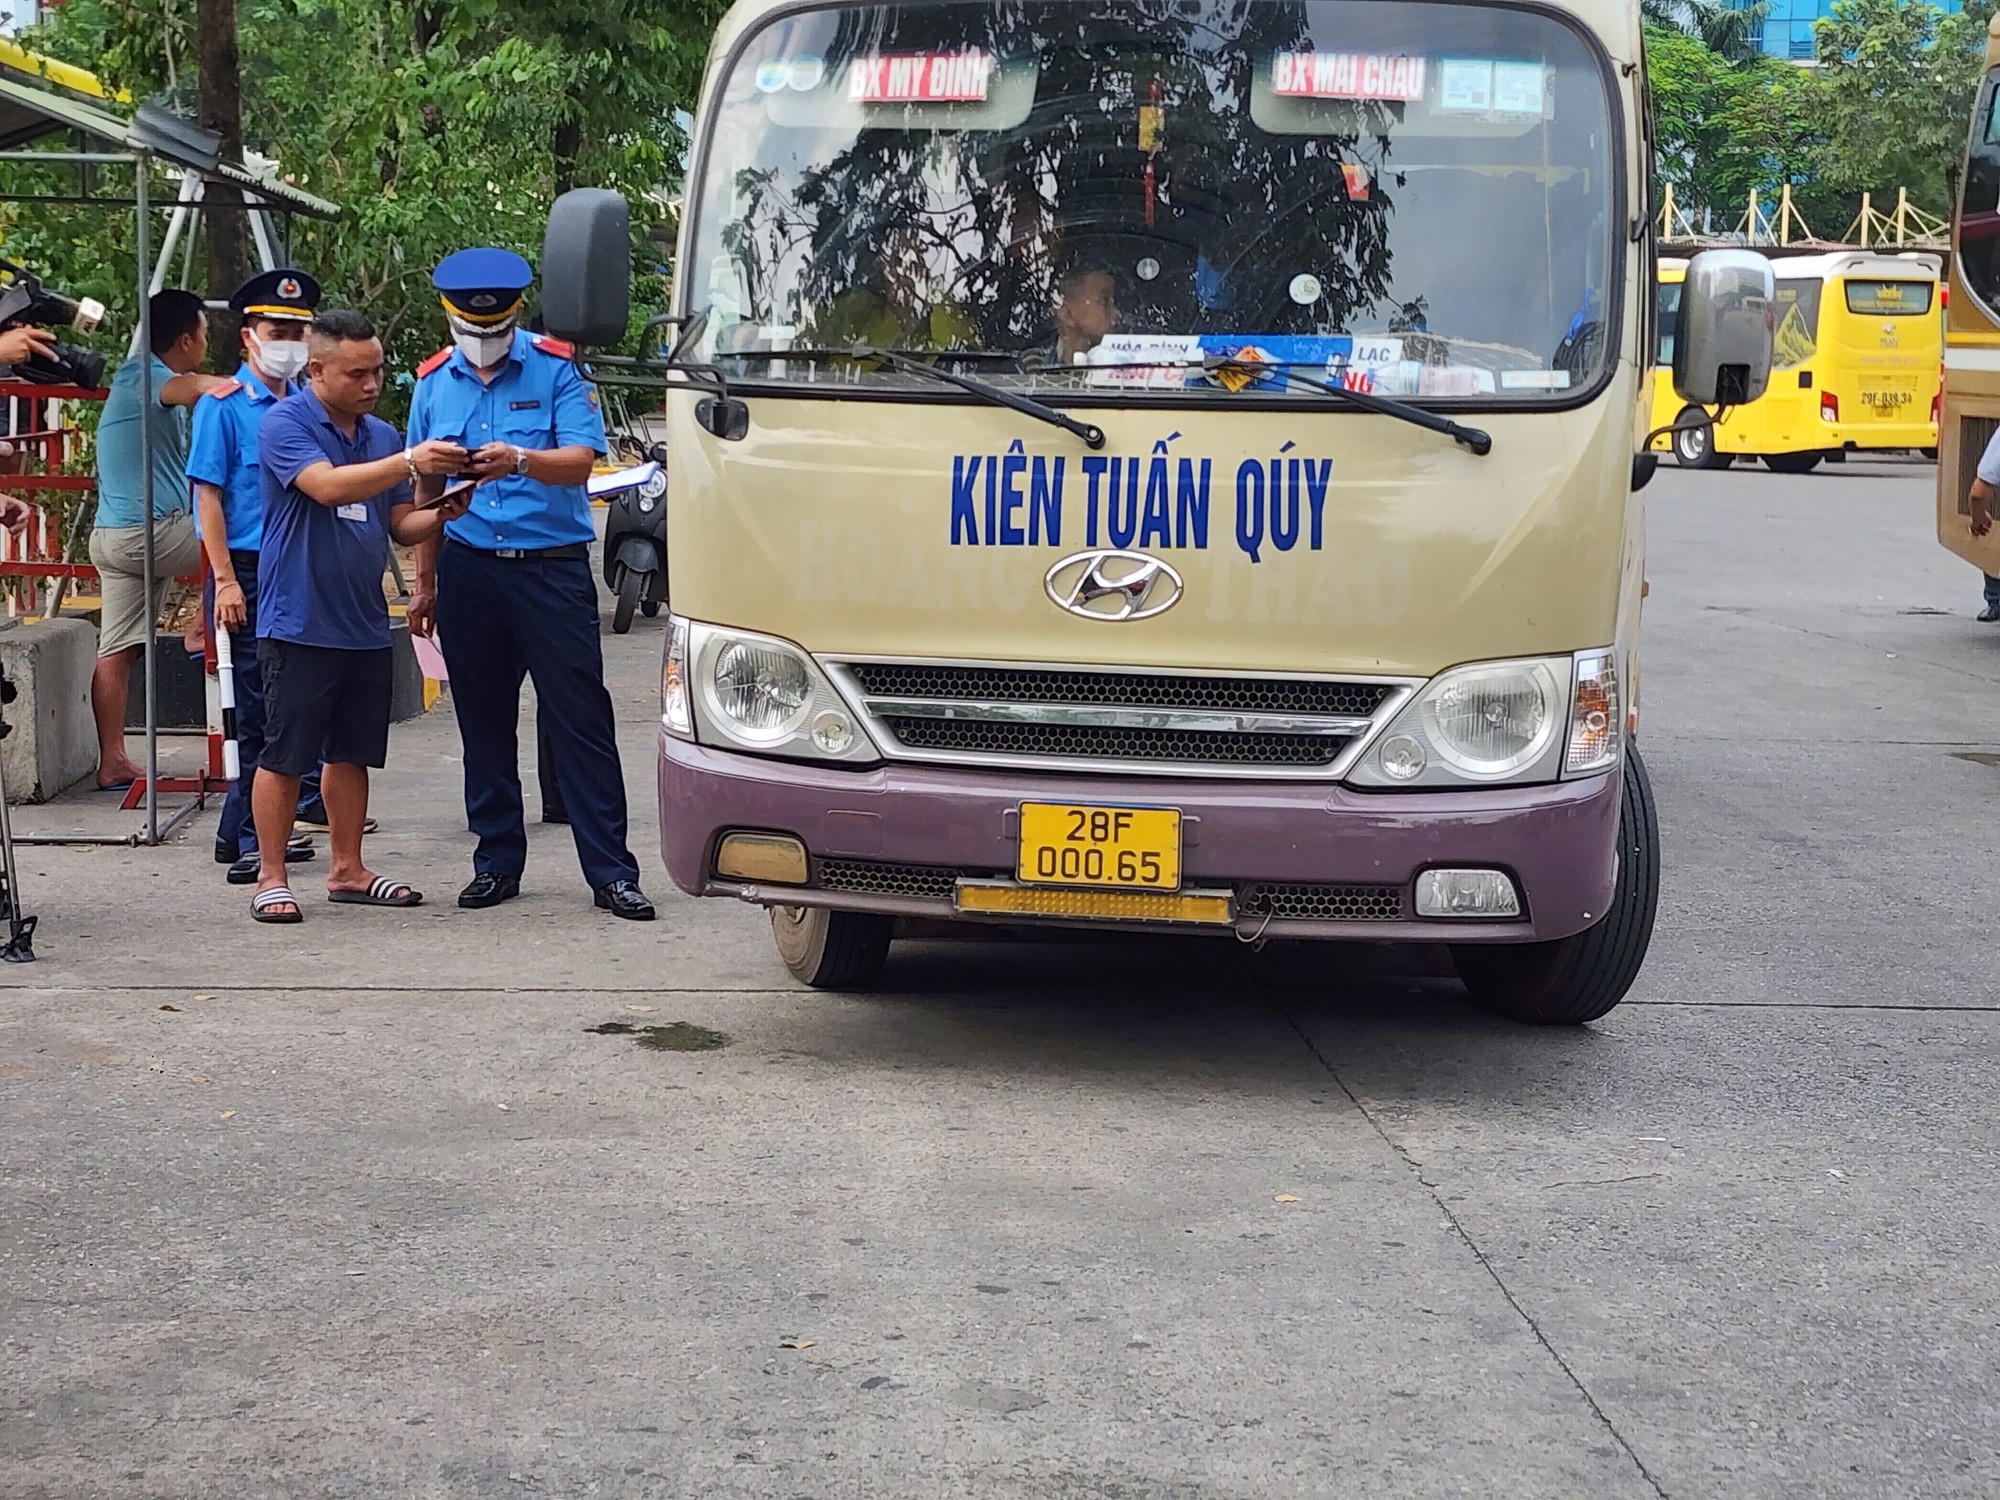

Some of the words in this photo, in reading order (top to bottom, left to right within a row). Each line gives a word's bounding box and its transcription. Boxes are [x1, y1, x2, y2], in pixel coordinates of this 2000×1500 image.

[850, 56, 885, 98] BX
[1277, 52, 1313, 92] BX
[1313, 53, 1358, 94] MAI
[1358, 346, 1391, 364] LẠC
[950, 439, 1066, 547] KIÊN
[1081, 431, 1213, 549] TUẤN
[1236, 440, 1333, 563] QÚY
[1066, 810, 1134, 843] 28F
[1037, 846, 1162, 883] 000.65
